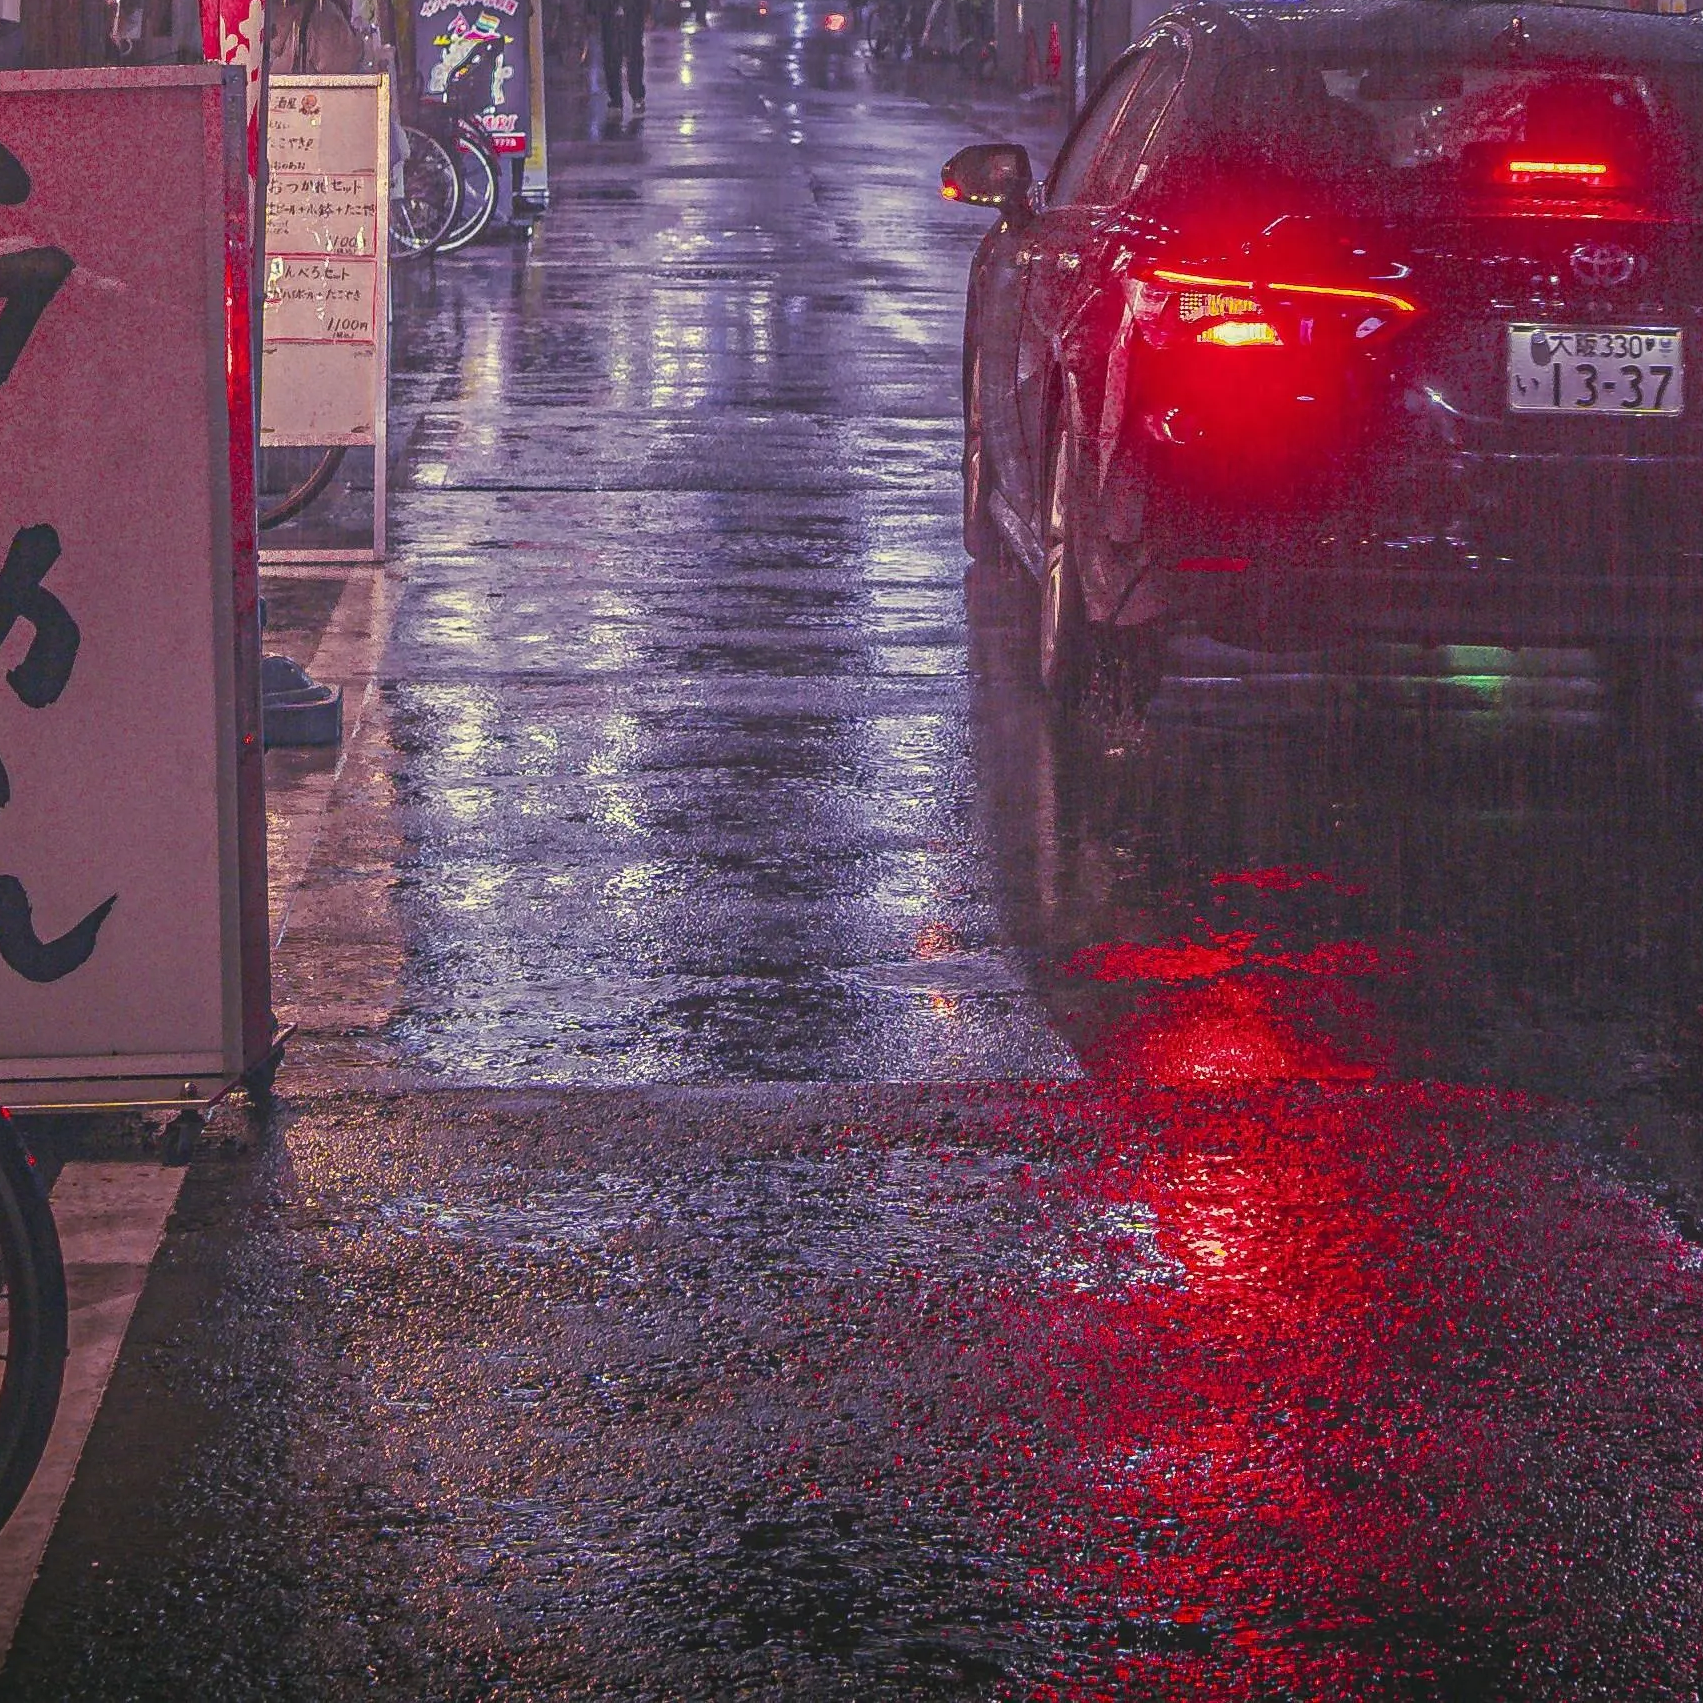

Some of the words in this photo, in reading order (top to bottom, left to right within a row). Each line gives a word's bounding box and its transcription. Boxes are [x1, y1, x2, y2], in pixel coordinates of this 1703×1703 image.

[1549, 334, 1597, 358] 大阪
[1599, 334, 1644, 359] 330
[1553, 362, 1674, 410] 13-37
